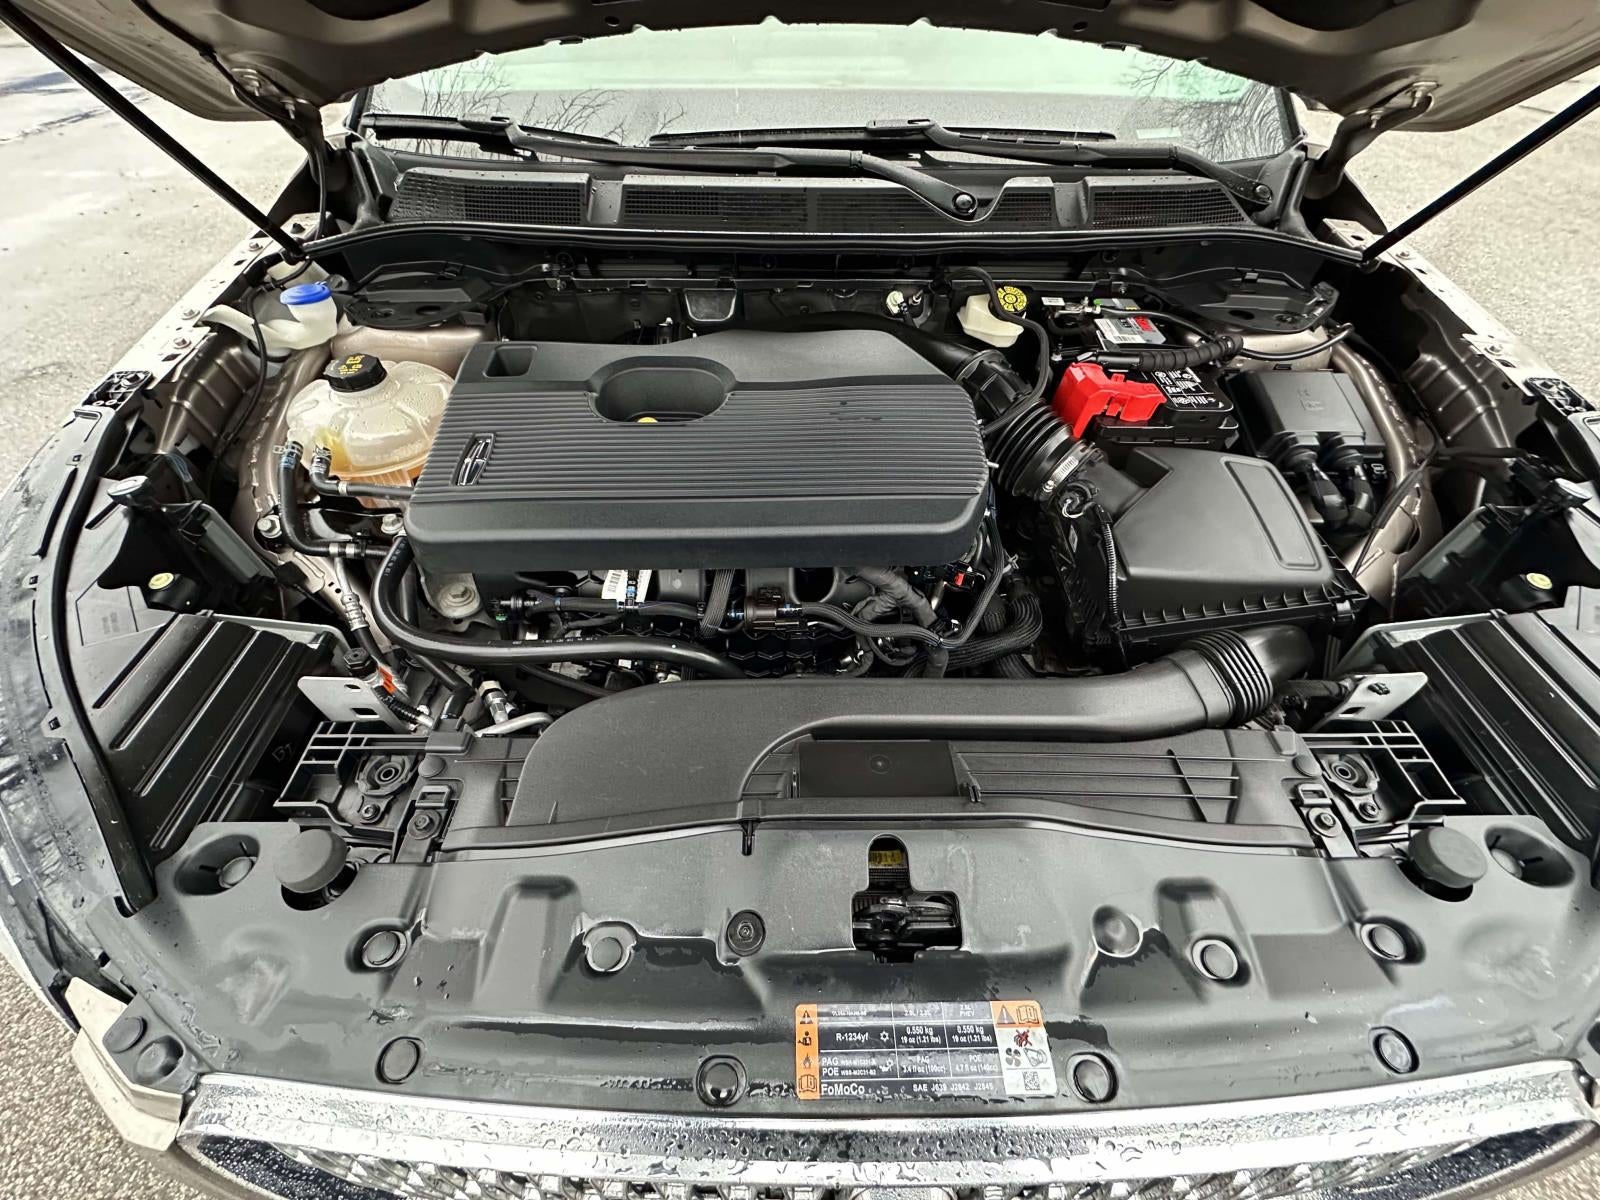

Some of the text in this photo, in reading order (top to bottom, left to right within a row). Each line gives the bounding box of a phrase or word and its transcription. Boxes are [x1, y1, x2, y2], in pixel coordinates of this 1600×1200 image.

[906, 1026, 933, 1036] 0.550 kg
[957, 1025, 984, 1035] 0.550 kg
[836, 1032, 869, 1043] R-1234yf
[901, 1035, 908, 1044] 19
[952, 1035, 959, 1043] 19
[821, 1057, 838, 1066] PAG
[822, 1067, 839, 1076] POE
[821, 1083, 865, 1096] FoMoCo
[913, 1083, 928, 1092] SAE
